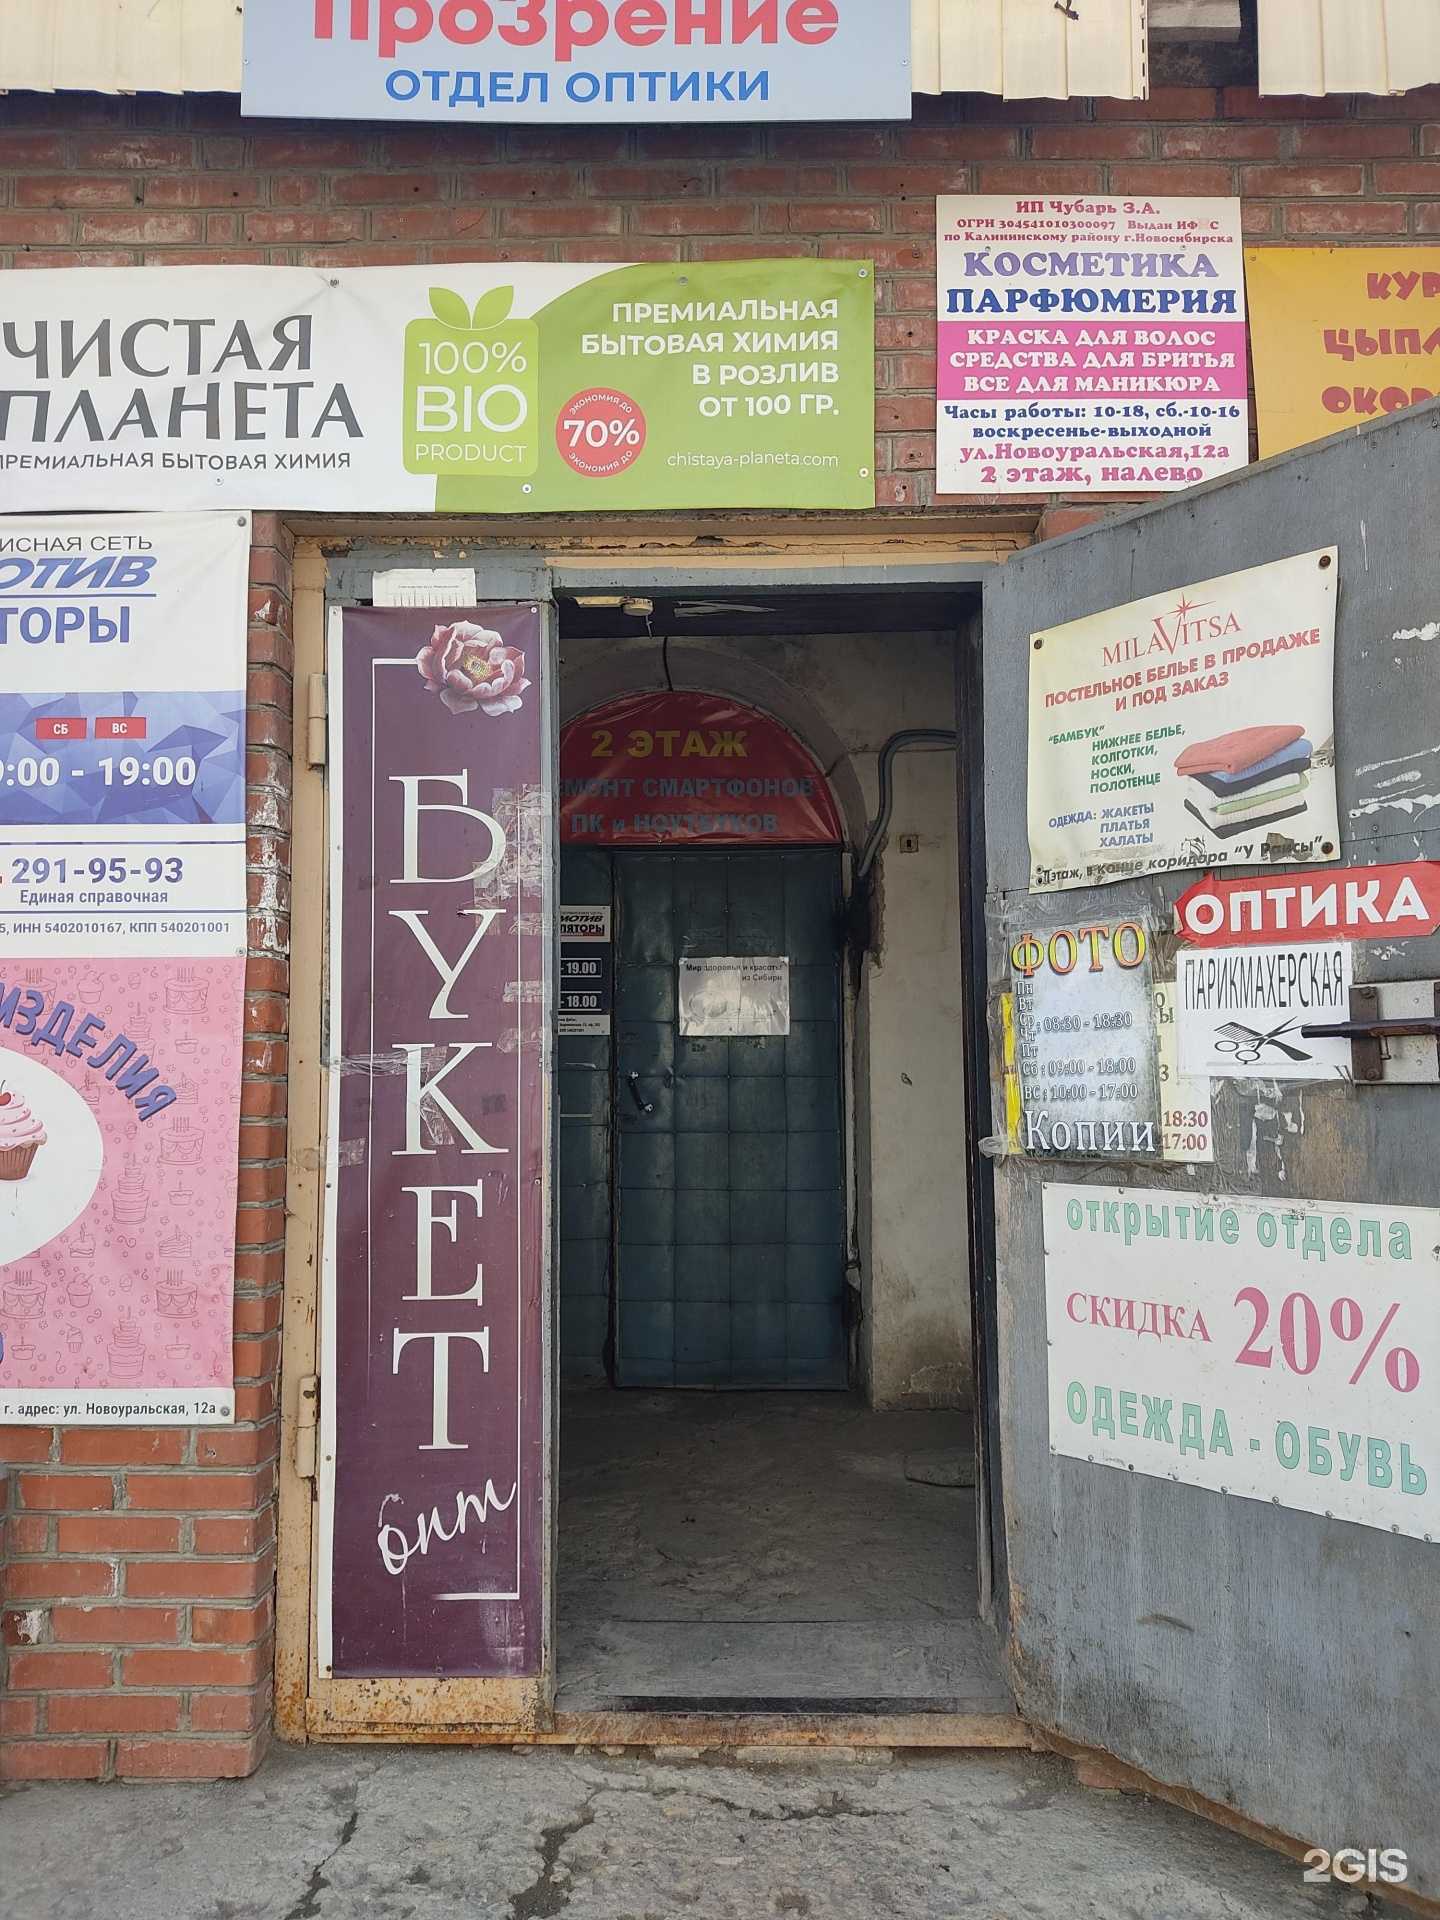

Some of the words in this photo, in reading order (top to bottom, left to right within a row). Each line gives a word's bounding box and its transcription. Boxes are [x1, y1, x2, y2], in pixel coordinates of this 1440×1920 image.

[314, 0, 839, 62] Прозрение
[385, 70, 549, 107] ОТДЕЛ
[565, 70, 770, 103] ОПТИКИ
[1015, 201, 1044, 214] ИП
[1050, 199, 1117, 215] Чубарь
[1123, 202, 1161, 214] З.А.
[956, 219, 995, 229] ОГРН
[1127, 220, 1173, 231] Выдан
[943, 233, 961, 242] по
[964, 231, 1066, 243] Калининскому
[1072, 231, 1120, 244] району
[962, 251, 1219, 278] КОСМЕТИКА
[612, 299, 838, 323] ПРЕМИАЛЬНАЯ
[946, 288, 1238, 314] ПАРФЮМЕРИЯ
[2, 315, 313, 379] ЧИСТАЯ
[581, 331, 724, 355] БЫТОВАЯ
[732, 330, 838, 352] ХИМИЯ
[967, 329, 1069, 346] КРАСКА
[1075, 329, 1128, 347] ДЛЯ
[1134, 330, 1216, 346] ВОЛОС
[418, 341, 527, 375] 100%
[950, 351, 1077, 369] СРЕДСТВА
[1082, 351, 1135, 369] ДЛЯ
[1141, 352, 1236, 368] БРИТЬЯ
[692, 364, 711, 384] В
[719, 362, 839, 385] РОЗЛИВ
[963, 375, 1010, 392] ВСЕ
[1015, 375, 1069, 394] ДЛЯ
[1074, 375, 1221, 393] МАНИКЮРА
[0, 381, 364, 442] ПЛАНЕТА
[415, 384, 528, 433] BIO
[569, 393, 620, 416] ЭКОНОМИЯ
[619, 400, 633, 414] ДО
[699, 396, 738, 417] ОТ
[744, 395, 791, 416] 100
[800, 393, 839, 415] ГР.
[944, 404, 997, 419] Часы
[1004, 402, 1086, 421] работы:
[1092, 405, 1150, 419] 10-18,
[563, 418, 640, 447] 70%
[972, 423, 1212, 438] воскресенье-выходной
[161, 452, 266, 469] БЫТОВАЯ
[274, 452, 351, 468] ХИМИЯ
[415, 443, 528, 462] PRODUCT
[568, 452, 620, 472] ЭКОНОМИЯ
[621, 449, 634, 465] ДО
[667, 451, 839, 469] chistaya-planeta.com
[980, 466, 997, 483] 2
[1006, 468, 1092, 486] этаж,
[1100, 465, 1203, 484] налево
[90, 535, 153, 550] СЕТЬ
[0, 556, 157, 589] ОТИВ
[0, 606, 130, 644] ТОРЫ
[1045, 671, 1142, 708] ПОСТЕЛЬНОЕ
[1146, 657, 1199, 684] БЕЛЬЕ
[1204, 654, 1216, 668] В
[1222, 628, 1321, 666] ПРОДАЖЕ
[1115, 697, 1128, 712] И
[1132, 688, 1168, 709] ПОД
[1171, 671, 1230, 697] ЗАКАЗ
[53, 723, 68, 735] СБ
[112, 722, 127, 734] ВС
[1092, 733, 1142, 751] НИЖНЕЕ
[1145, 724, 1186, 742] БЕЛЬЕ,
[591, 731, 613, 757] 2
[627, 730, 749, 758] ЭТАЖ
[1091, 745, 1158, 765] КОЛГОТКИ,
[0, 757, 60, 786] :00
[98, 757, 196, 786] 19:00
[1090, 763, 1136, 779] НОСКИ,
[560, 778, 634, 797] МОНТ
[1090, 773, 1161, 793] ПОЛОТЕНЦЕ
[571, 816, 603, 833] ПК
[1048, 811, 1097, 829] ОДЕЖДА:
[1101, 803, 1154, 819] ЖАКЕТЫ
[1100, 818, 1151, 833] ПЛАТЬЯ
[1099, 833, 1154, 847] ХАЛАТЫ
[11, 858, 184, 884] 291-95-93
[1148, 852, 1228, 871] коридора
[20, 890, 74, 905] Единая
[79, 892, 168, 906] справочная
[1186, 876, 1430, 936] ОПТИКА
[13, 923, 41, 933] ИНН
[44, 922, 126, 934] 5402010167,
[130, 923, 157, 932] КПП
[161, 922, 229, 933] 540201001
[1010, 922, 1147, 976] ФОТО
[566, 961, 597, 975] 19.00
[686, 963, 701, 971] Мир
[1016, 981, 1033, 995] Пн
[1185, 950, 1344, 1010] ПАРИКМАХЕРСКАЯ
[566, 995, 598, 1008] 18.00
[1018, 997, 1033, 1011] Вт
[1019, 1012, 1035, 1028] Ср
[0, 982, 177, 1122] ИЗДЕЛИЯ
[1021, 1043, 1038, 1057] Пт
[1100, 1083, 1138, 1099] 17:00
[1164, 1110, 1208, 1128] 18:30
[1024, 1110, 1155, 1152] Копии
[1164, 1133, 1207, 1150] 17:00
[1066, 1199, 1241, 1246] открытие
[1256, 1212, 1413, 1261] отдела
[1066, 1292, 1213, 1343] СКИДКА
[1233, 1286, 1420, 1393] 20%
[4, 1406, 13, 1414] г.
[18, 1404, 59, 1416] адрес:
[63, 1405, 81, 1417] ул.
[86, 1404, 189, 1417] Новоуральская,
[195, 1403, 216, 1414] 12а
[1066, 1381, 1234, 1459] ОДЕЖДА
[1275, 1420, 1428, 1496] ОБУВЬ
